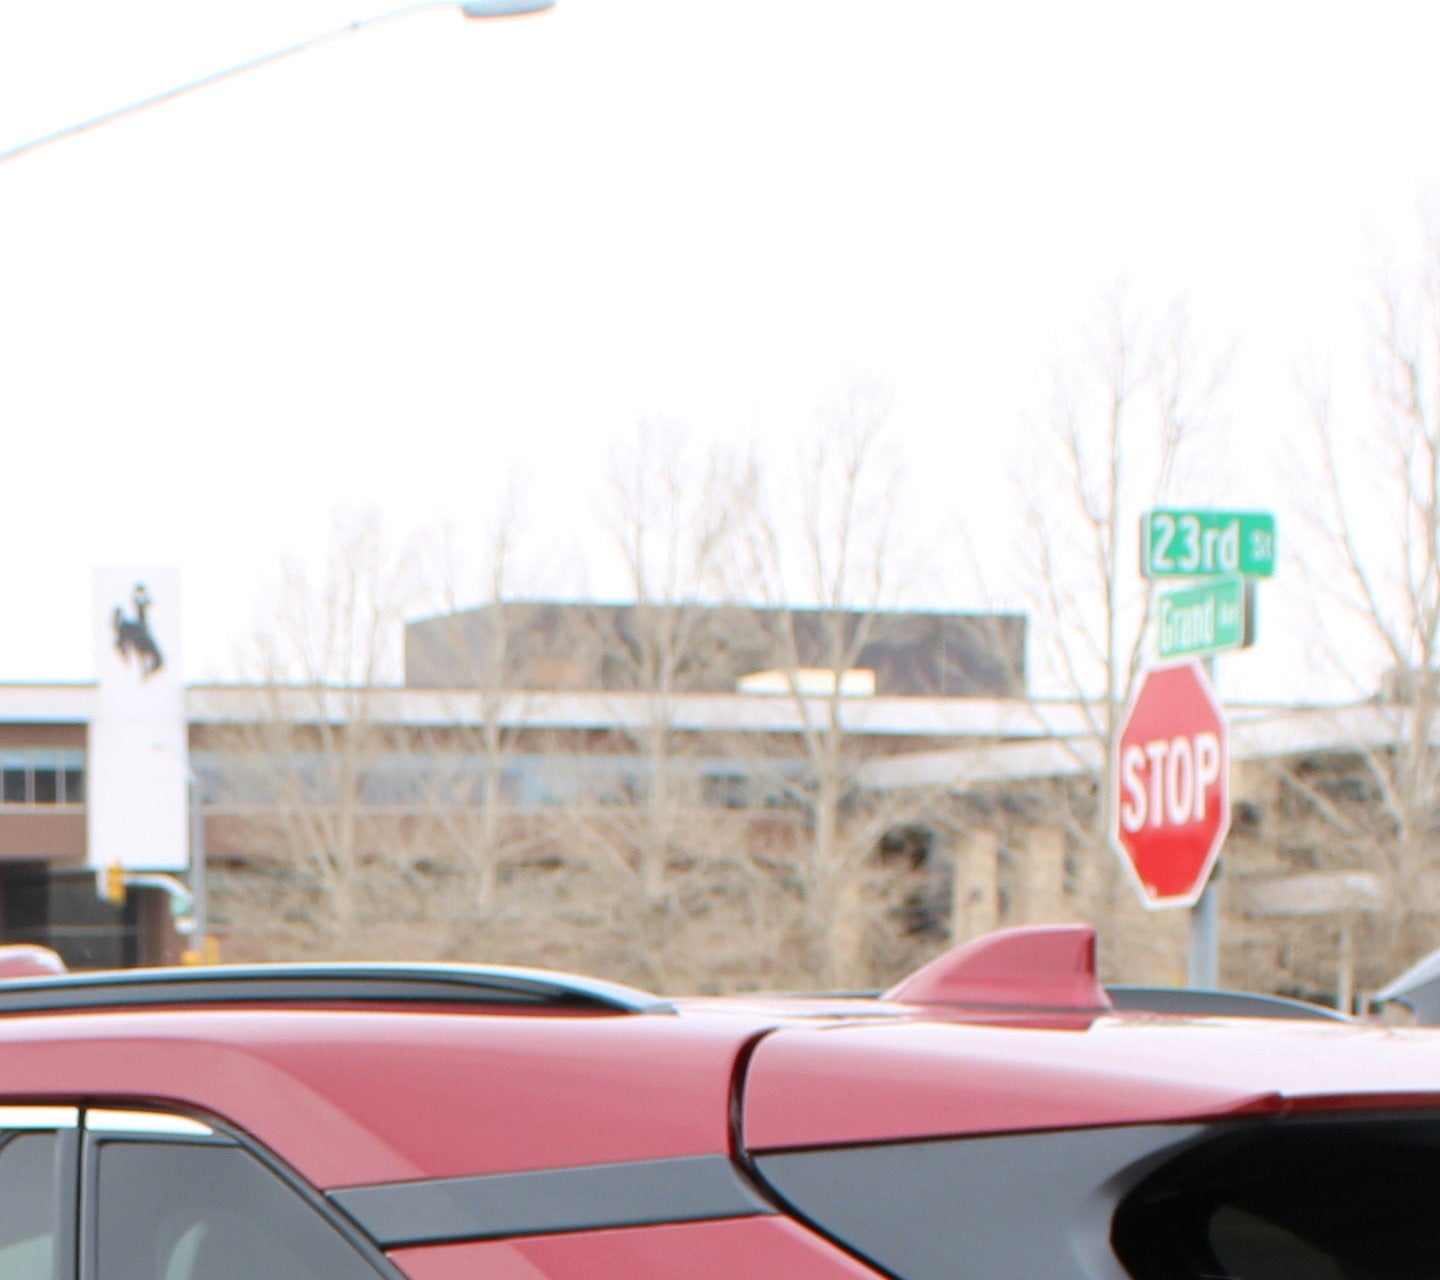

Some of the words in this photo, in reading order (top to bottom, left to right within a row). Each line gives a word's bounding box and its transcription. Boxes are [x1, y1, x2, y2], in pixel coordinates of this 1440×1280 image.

[1151, 514, 1240, 572] 23rd
[1160, 594, 1214, 653] Grand
[1122, 732, 1220, 832] STOP
